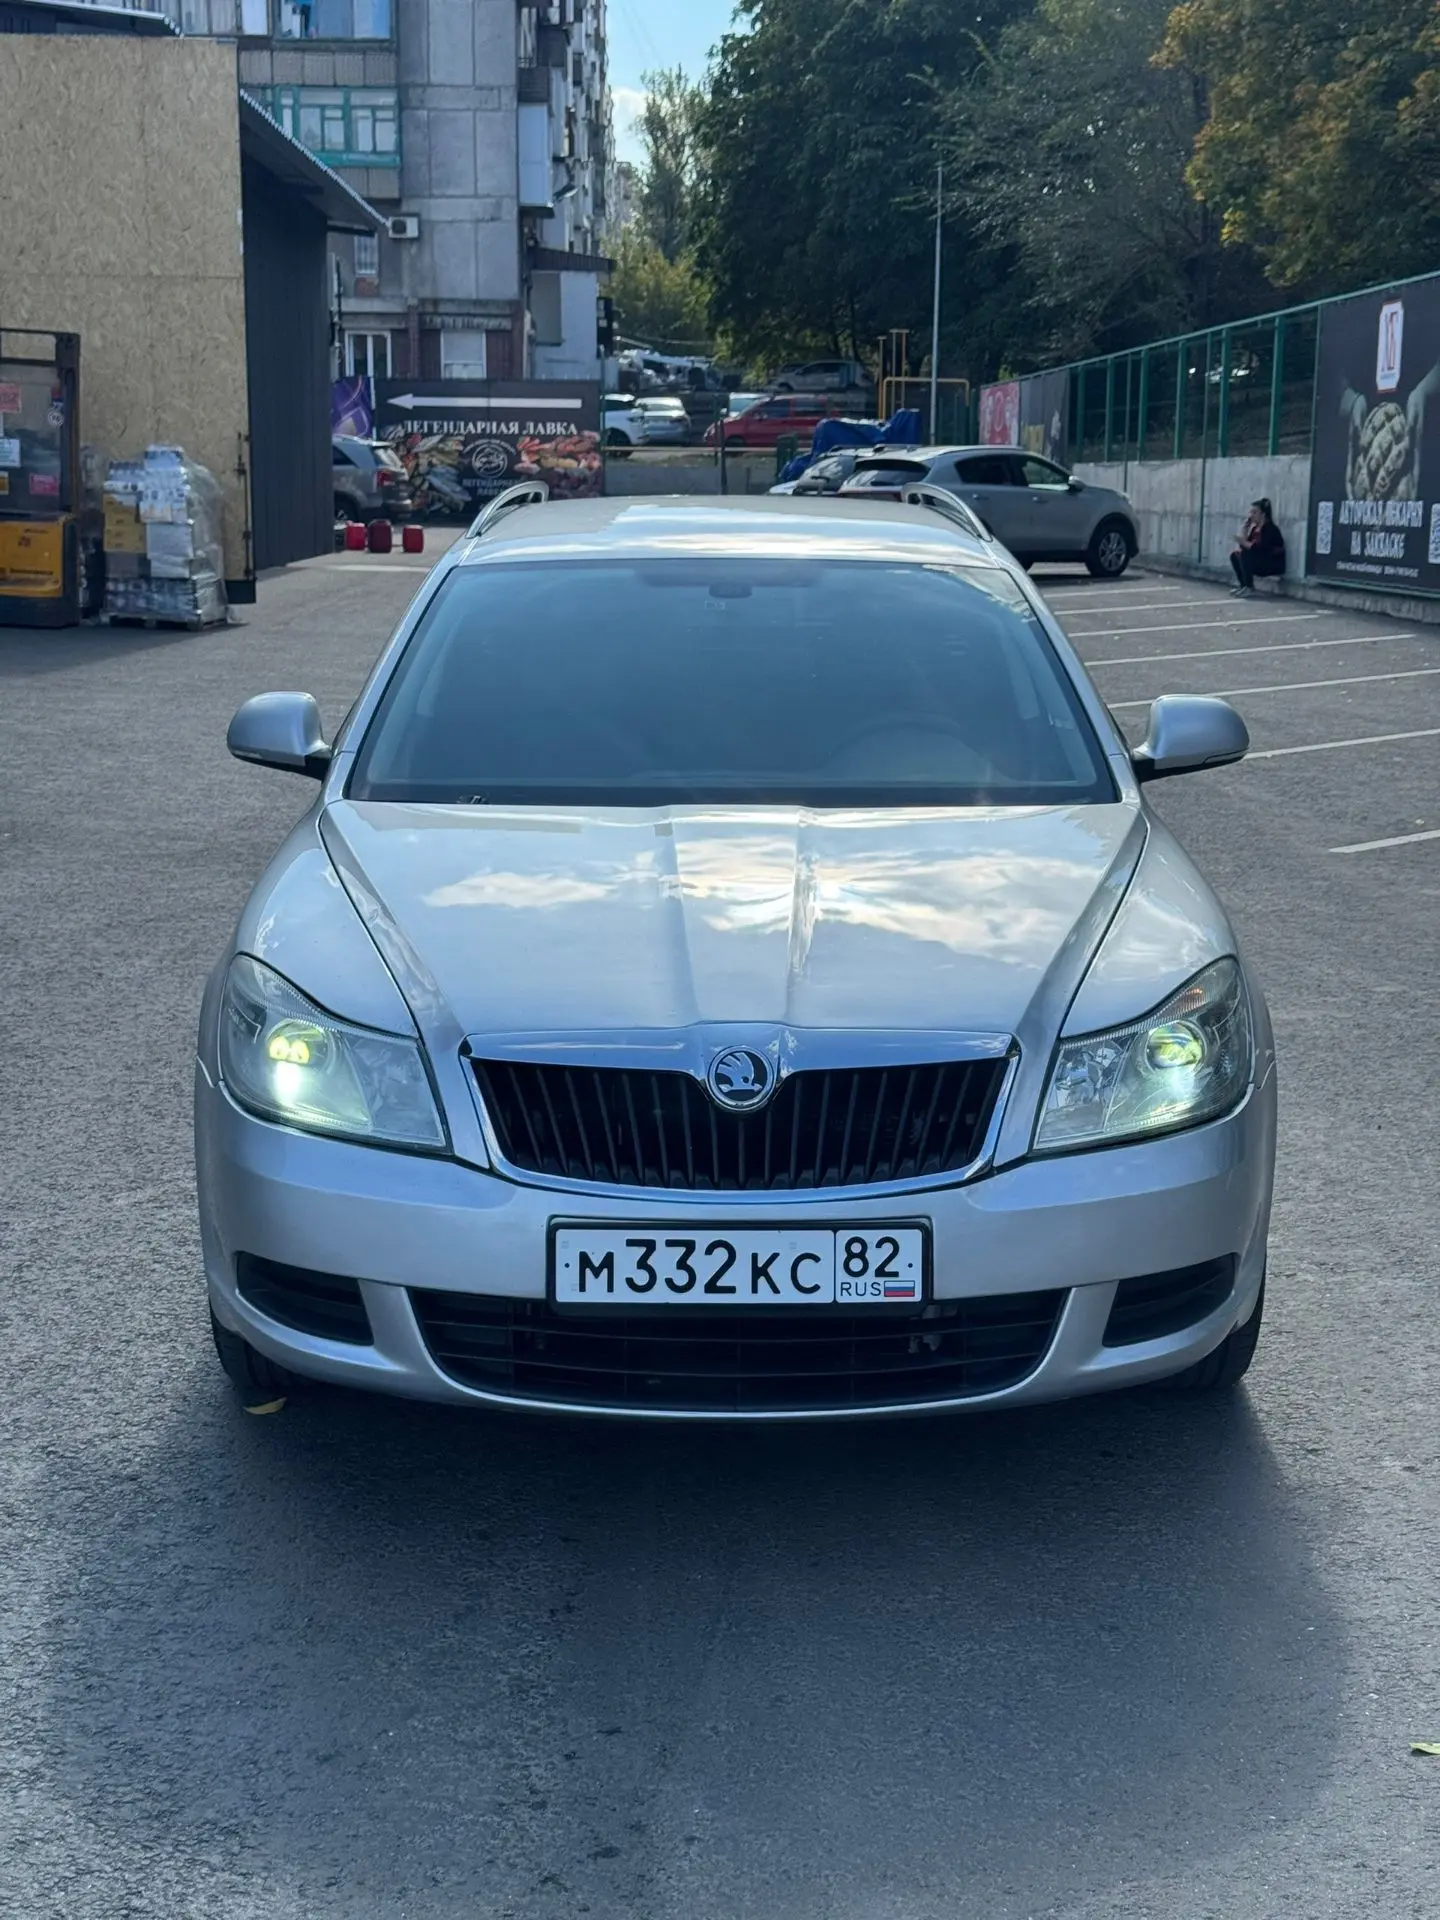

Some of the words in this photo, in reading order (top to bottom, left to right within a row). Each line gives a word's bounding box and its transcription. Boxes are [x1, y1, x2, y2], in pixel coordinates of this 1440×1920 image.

[402, 420, 519, 435] ЛЕГЕНДАРНАЯ
[522, 421, 578, 435] ЛАВКА
[578, 1238, 822, 1295] М332КС
[843, 1236, 900, 1278] 82
[839, 1281, 882, 1298] RUS
